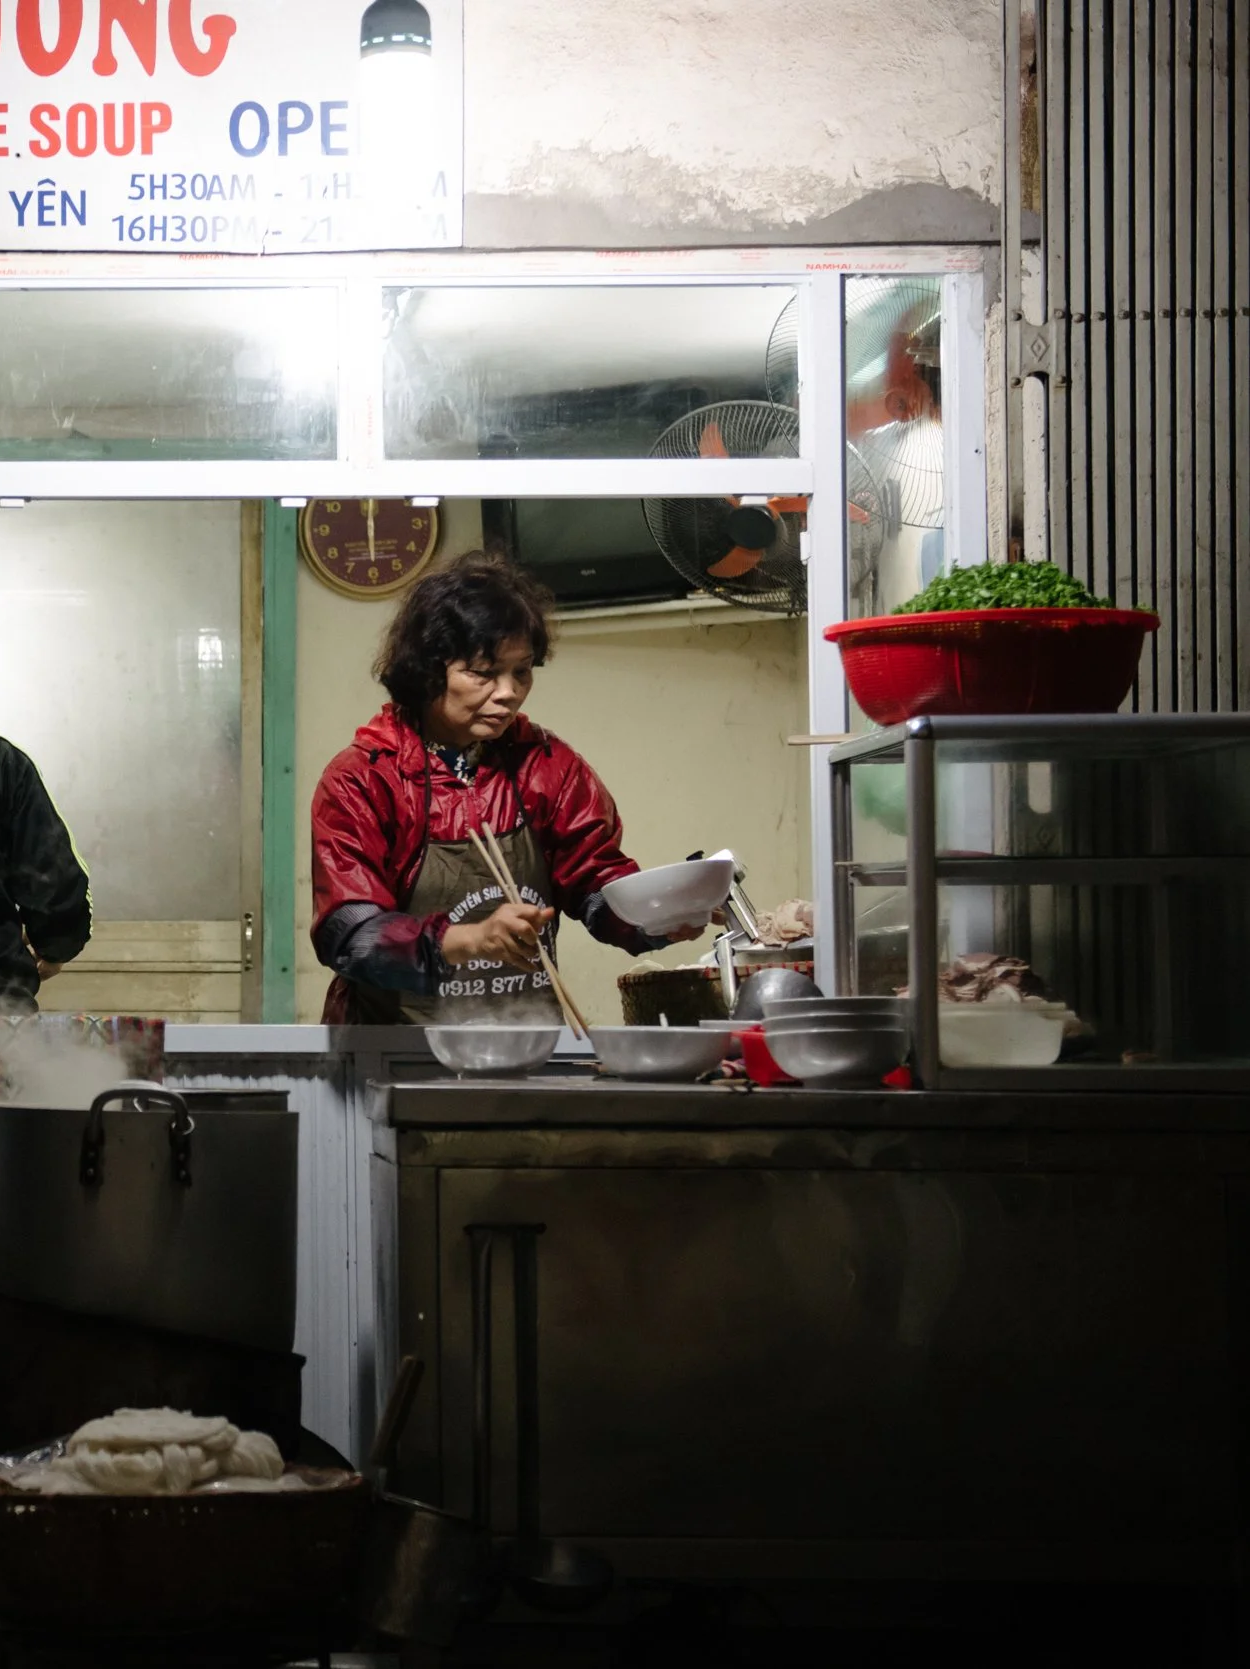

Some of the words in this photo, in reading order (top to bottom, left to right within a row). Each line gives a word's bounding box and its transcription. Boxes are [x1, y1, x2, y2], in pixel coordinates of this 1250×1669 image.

[30, 102, 173, 158] SOUP
[229, 100, 359, 157] OPE
[128, 172, 256, 201] 5H30AM
[10, 178, 87, 227] YÊN
[112, 214, 260, 244] 16H30PM
[325, 501, 341, 513] 10
[412, 517, 423, 529] 3
[319, 524, 330, 536] 9
[327, 547, 338, 559] 8
[406, 541, 416, 552] 4
[346, 562, 356, 574] 7
[391, 559, 402, 571] 5
[367, 566, 379, 579] 6
[520, 886, 539, 904] GAS
[438, 979, 486, 997] 0912
[491, 974, 527, 994] 877
